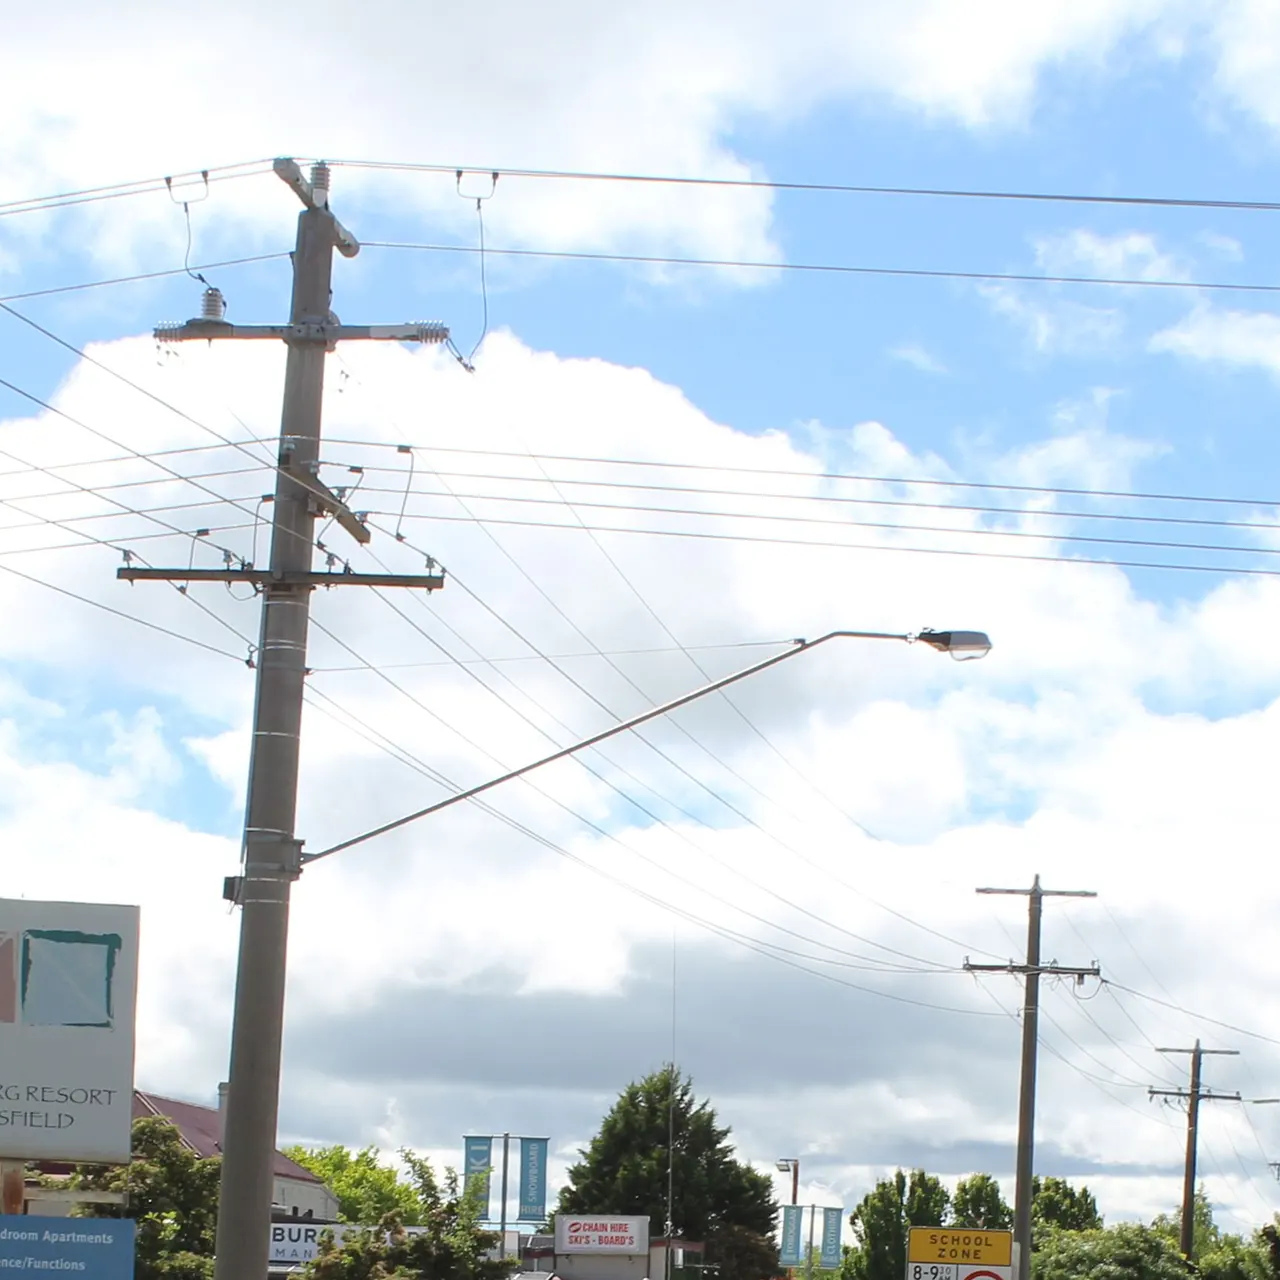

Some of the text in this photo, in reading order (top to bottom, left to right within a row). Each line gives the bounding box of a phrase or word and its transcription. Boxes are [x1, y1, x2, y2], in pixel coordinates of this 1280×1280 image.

[26, 1086, 118, 1106] RESORT
[528, 1143, 539, 1203] SNOWBOARD
[521, 1205, 545, 1215] HIRE
[582, 1222, 629, 1233] CHAIN HIRE
[827, 1211, 837, 1255] CLOTHING
[42, 1230, 114, 1245] Apartments
[568, 1235, 590, 1245] SKI'S
[598, 1236, 634, 1246] BOARD'S
[929, 1234, 993, 1247] SCHOOL
[937, 1248, 981, 1259] ZONE
